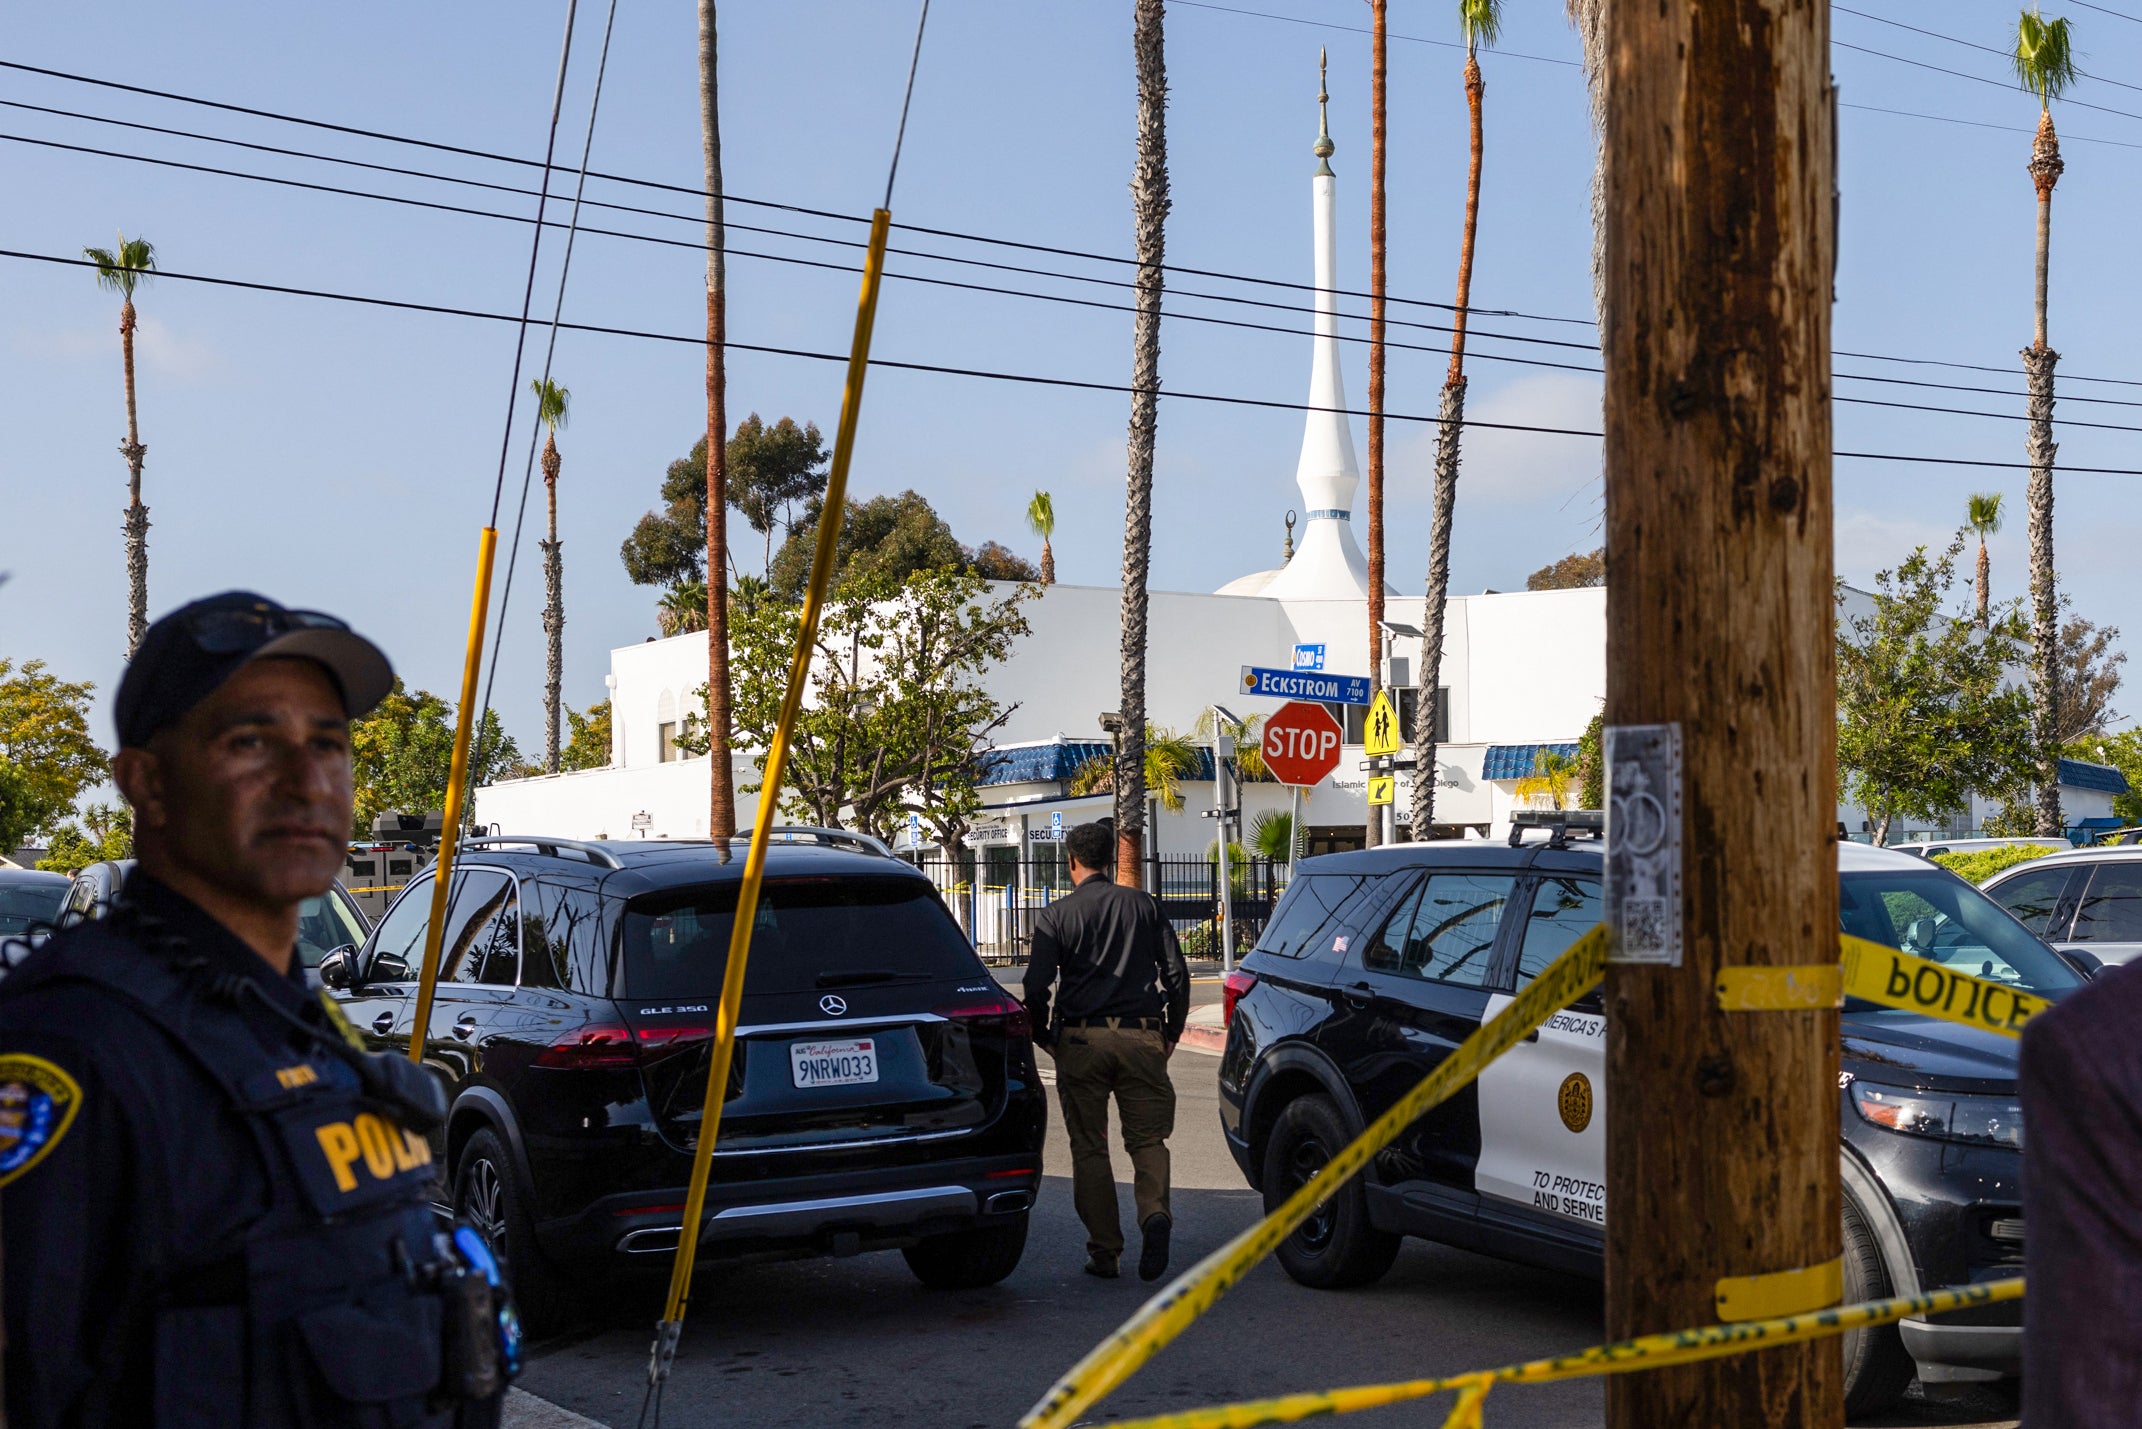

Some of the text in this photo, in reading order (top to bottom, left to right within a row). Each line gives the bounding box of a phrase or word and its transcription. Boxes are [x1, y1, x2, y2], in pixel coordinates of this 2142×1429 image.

[1296, 648, 1315, 667] COSMO
[1261, 672, 1338, 698] ECKSTROM
[1350, 679, 1361, 688] AV
[1346, 688, 1364, 697] 7100
[1267, 726, 1337, 761] STOP
[1332, 780, 1366, 789] Islamic
[1396, 812, 1410, 821] 50
[967, 828, 1008, 841] SECURITY OFFICE
[1029, 829, 1071, 840] SECUTY
[640, 1005, 709, 1015] GLE 350
[1540, 1013, 1599, 1037] MERICA'S
[808, 1044, 855, 1058] California
[799, 1055, 872, 1081] 9NRW033
[315, 1113, 432, 1193] POLI
[1532, 1170, 1607, 1201] TO PROTEC
[1533, 1191, 1604, 1222] AND SERVE
